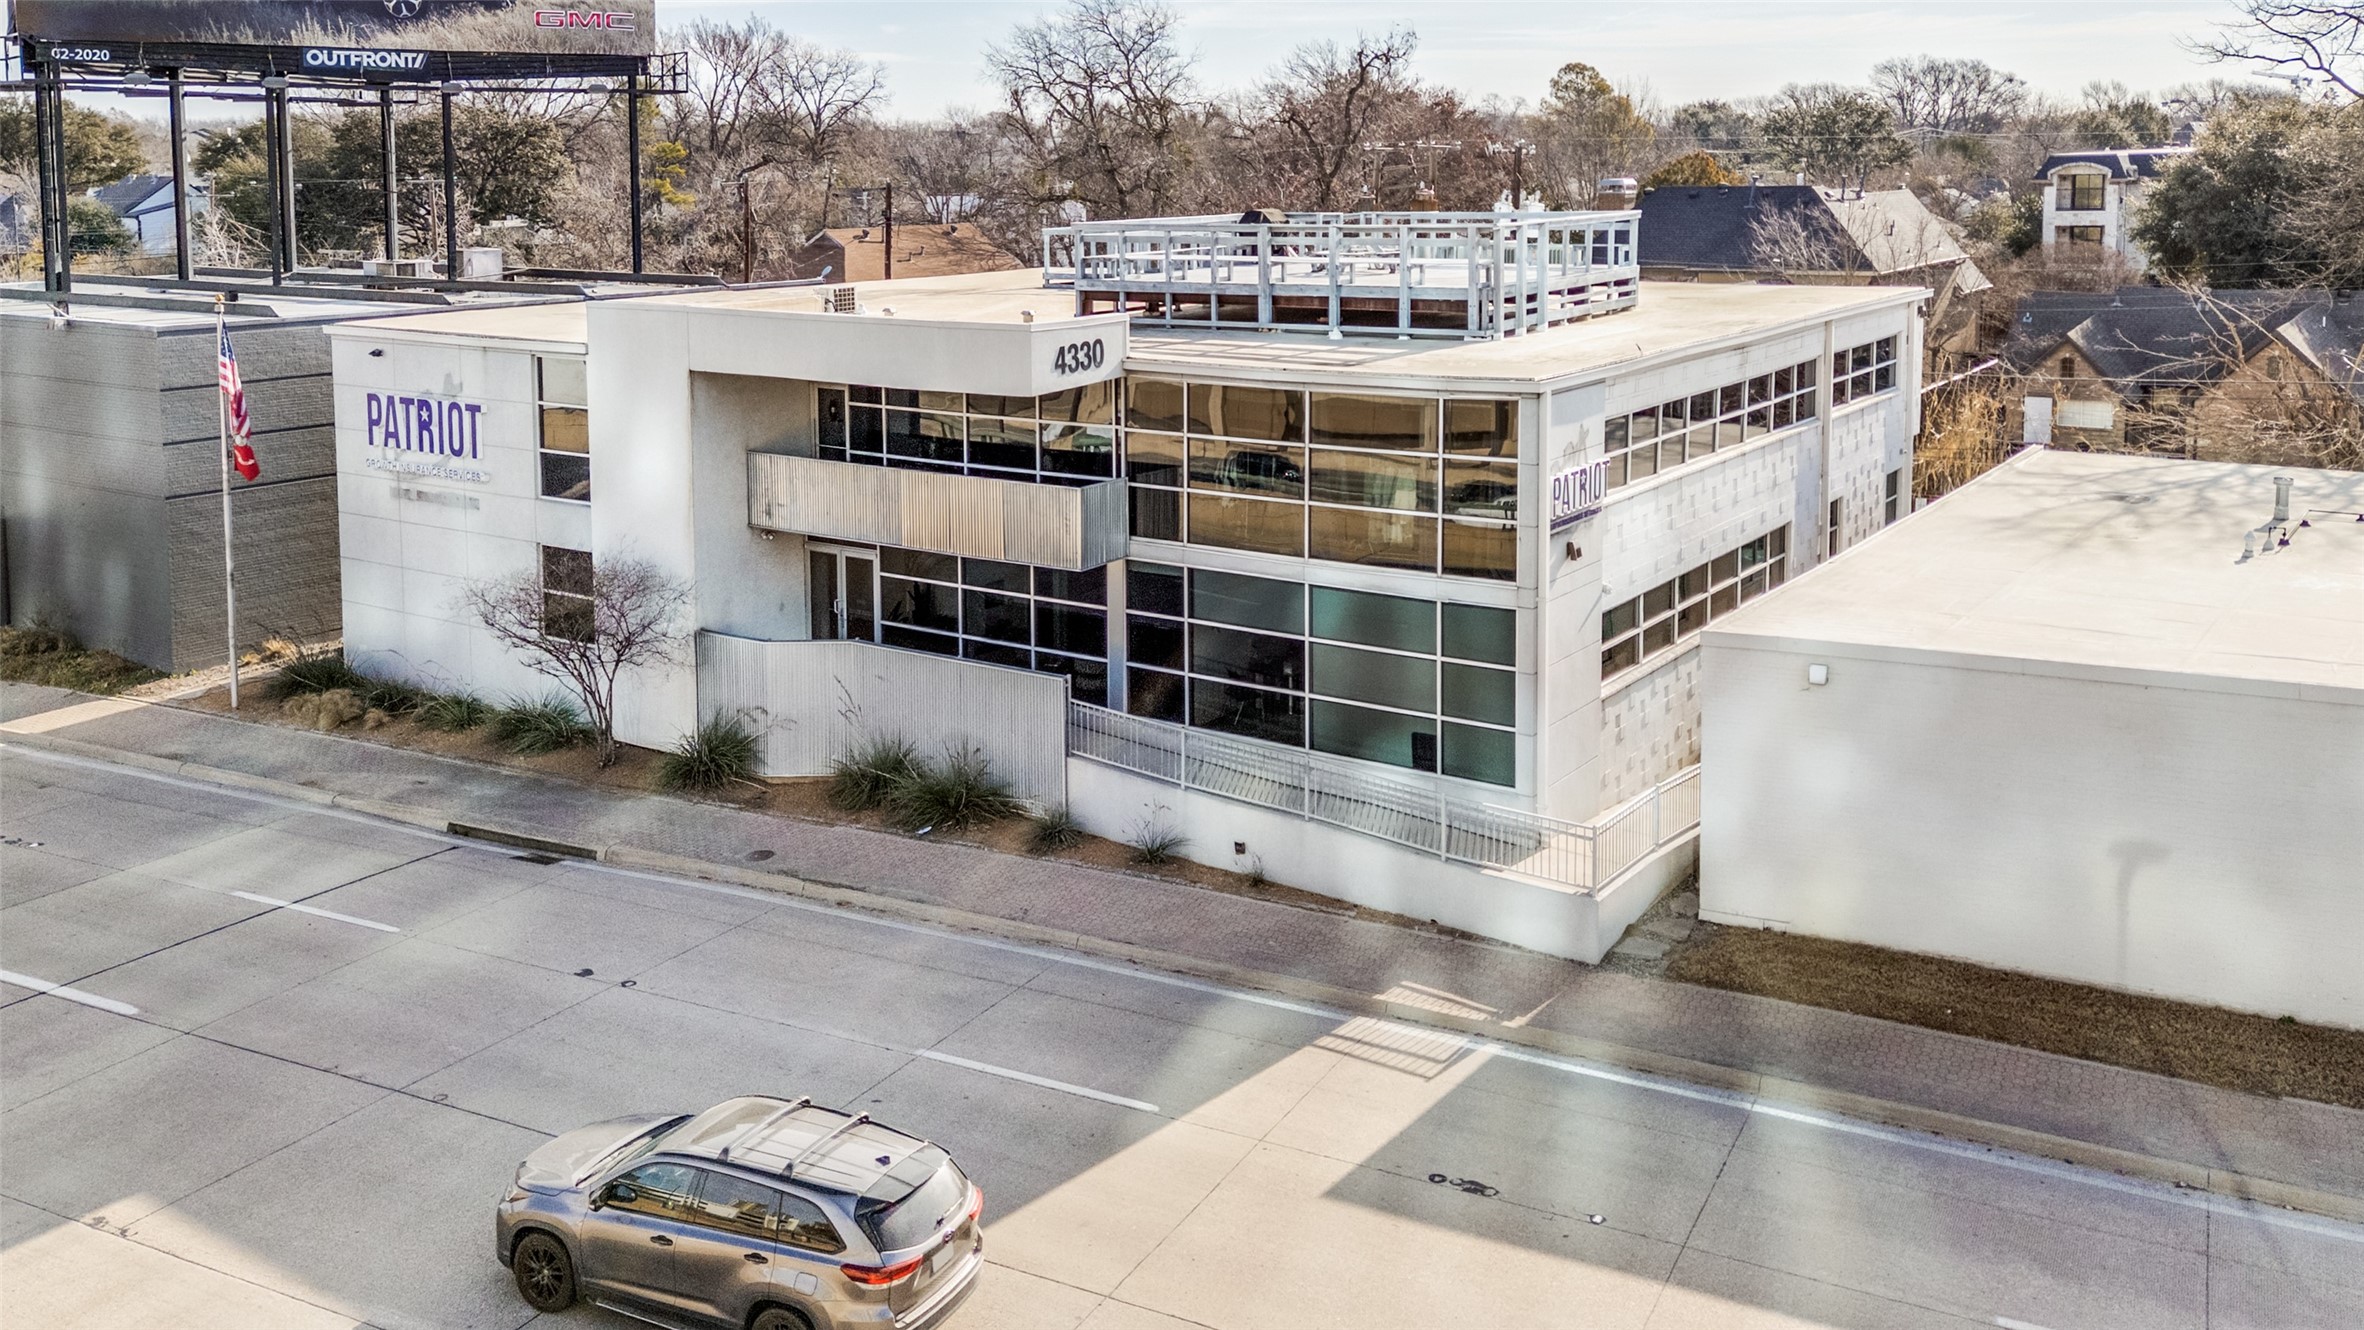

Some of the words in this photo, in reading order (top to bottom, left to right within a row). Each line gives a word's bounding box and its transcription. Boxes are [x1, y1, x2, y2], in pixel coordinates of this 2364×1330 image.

[534, 10, 634, 31] GMC
[51, 47, 110, 61] 02-2020
[1054, 338, 1105, 375] 4330
[367, 393, 481, 459] PATRIOT
[443, 469, 481, 481] SERVICES
[1553, 460, 1610, 519] PATRIOT
